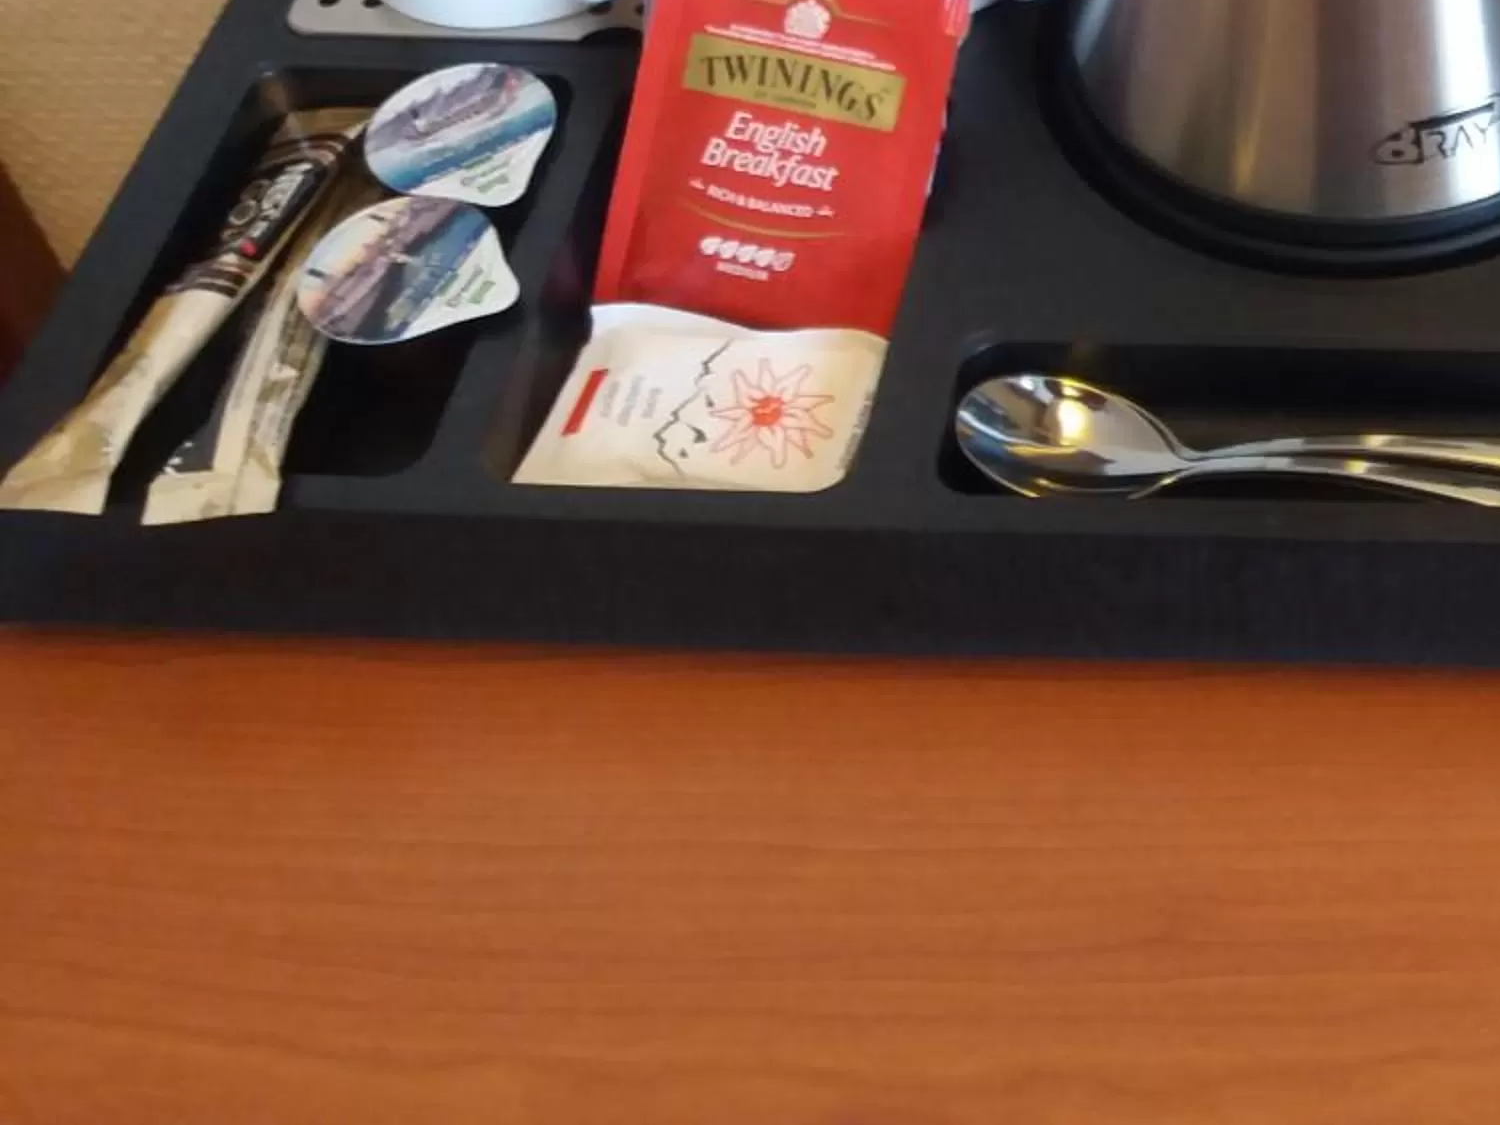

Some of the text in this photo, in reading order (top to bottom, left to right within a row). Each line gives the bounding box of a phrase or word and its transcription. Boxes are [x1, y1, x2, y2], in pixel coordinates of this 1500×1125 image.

[699, 52, 885, 123] TWININGS
[725, 112, 828, 159] English
[701, 137, 840, 192] Breakfast
